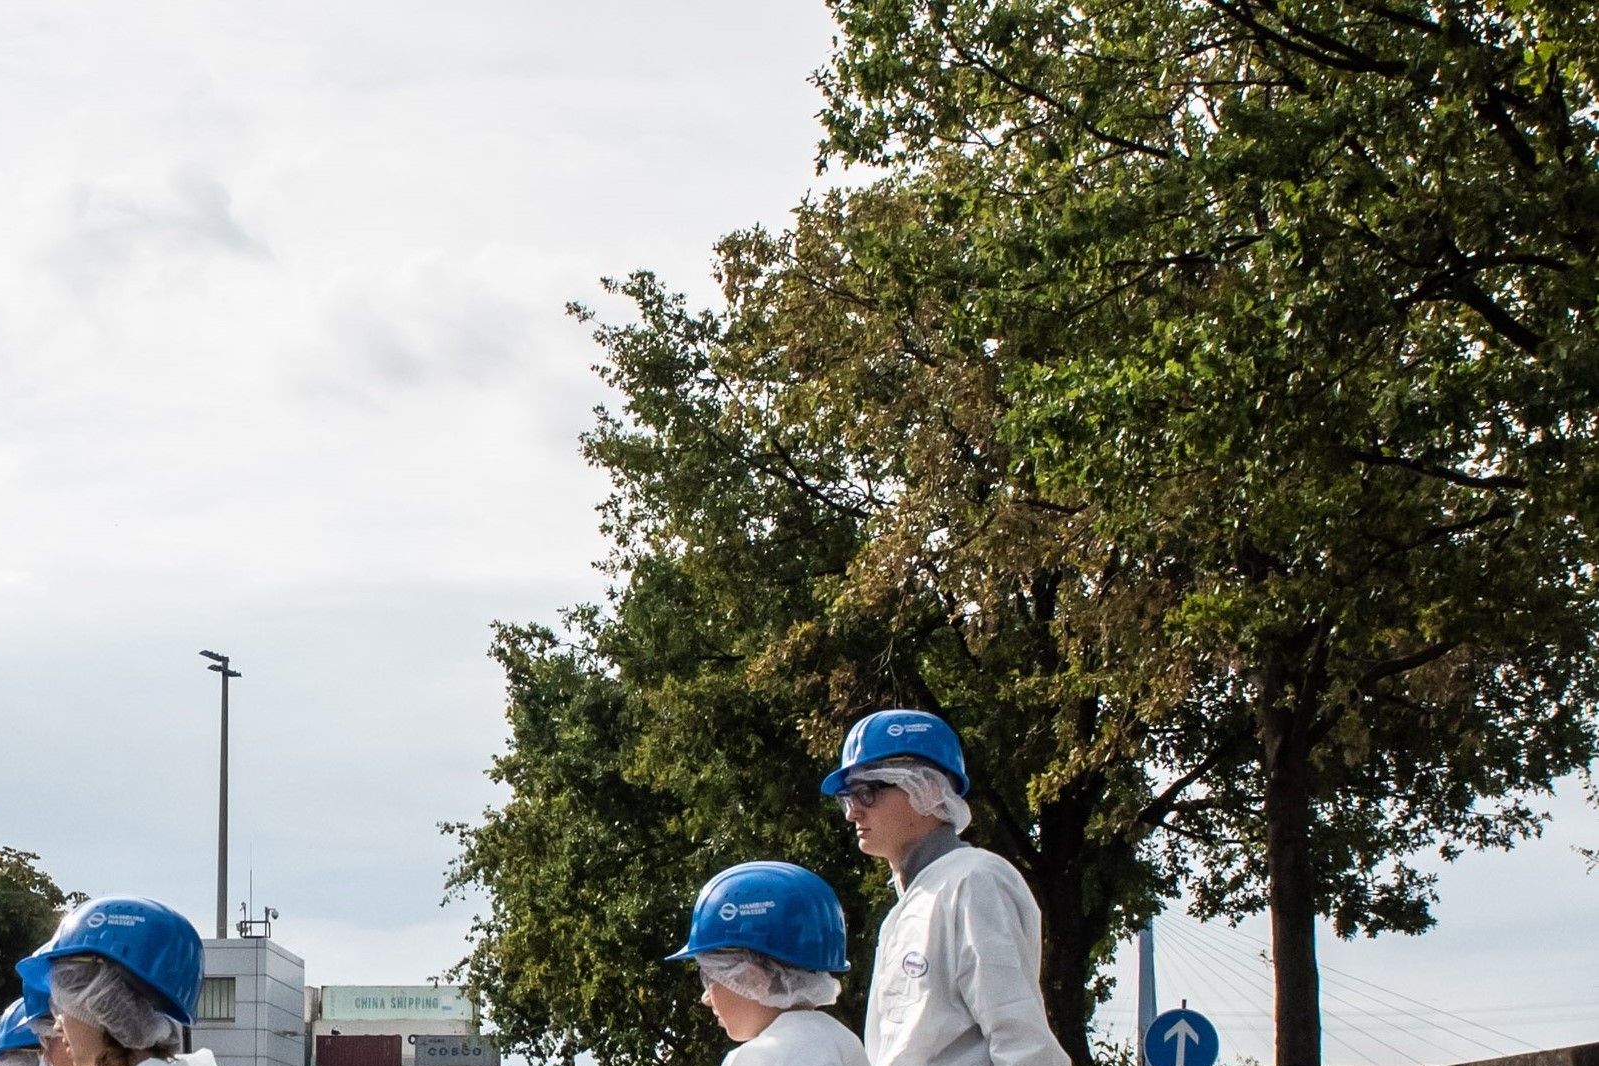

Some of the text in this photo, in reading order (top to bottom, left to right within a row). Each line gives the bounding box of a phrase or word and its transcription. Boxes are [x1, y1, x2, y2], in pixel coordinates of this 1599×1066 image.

[354, 997, 438, 1009] CHINA SHIPPING
[428, 1047, 481, 1056] COSCO
